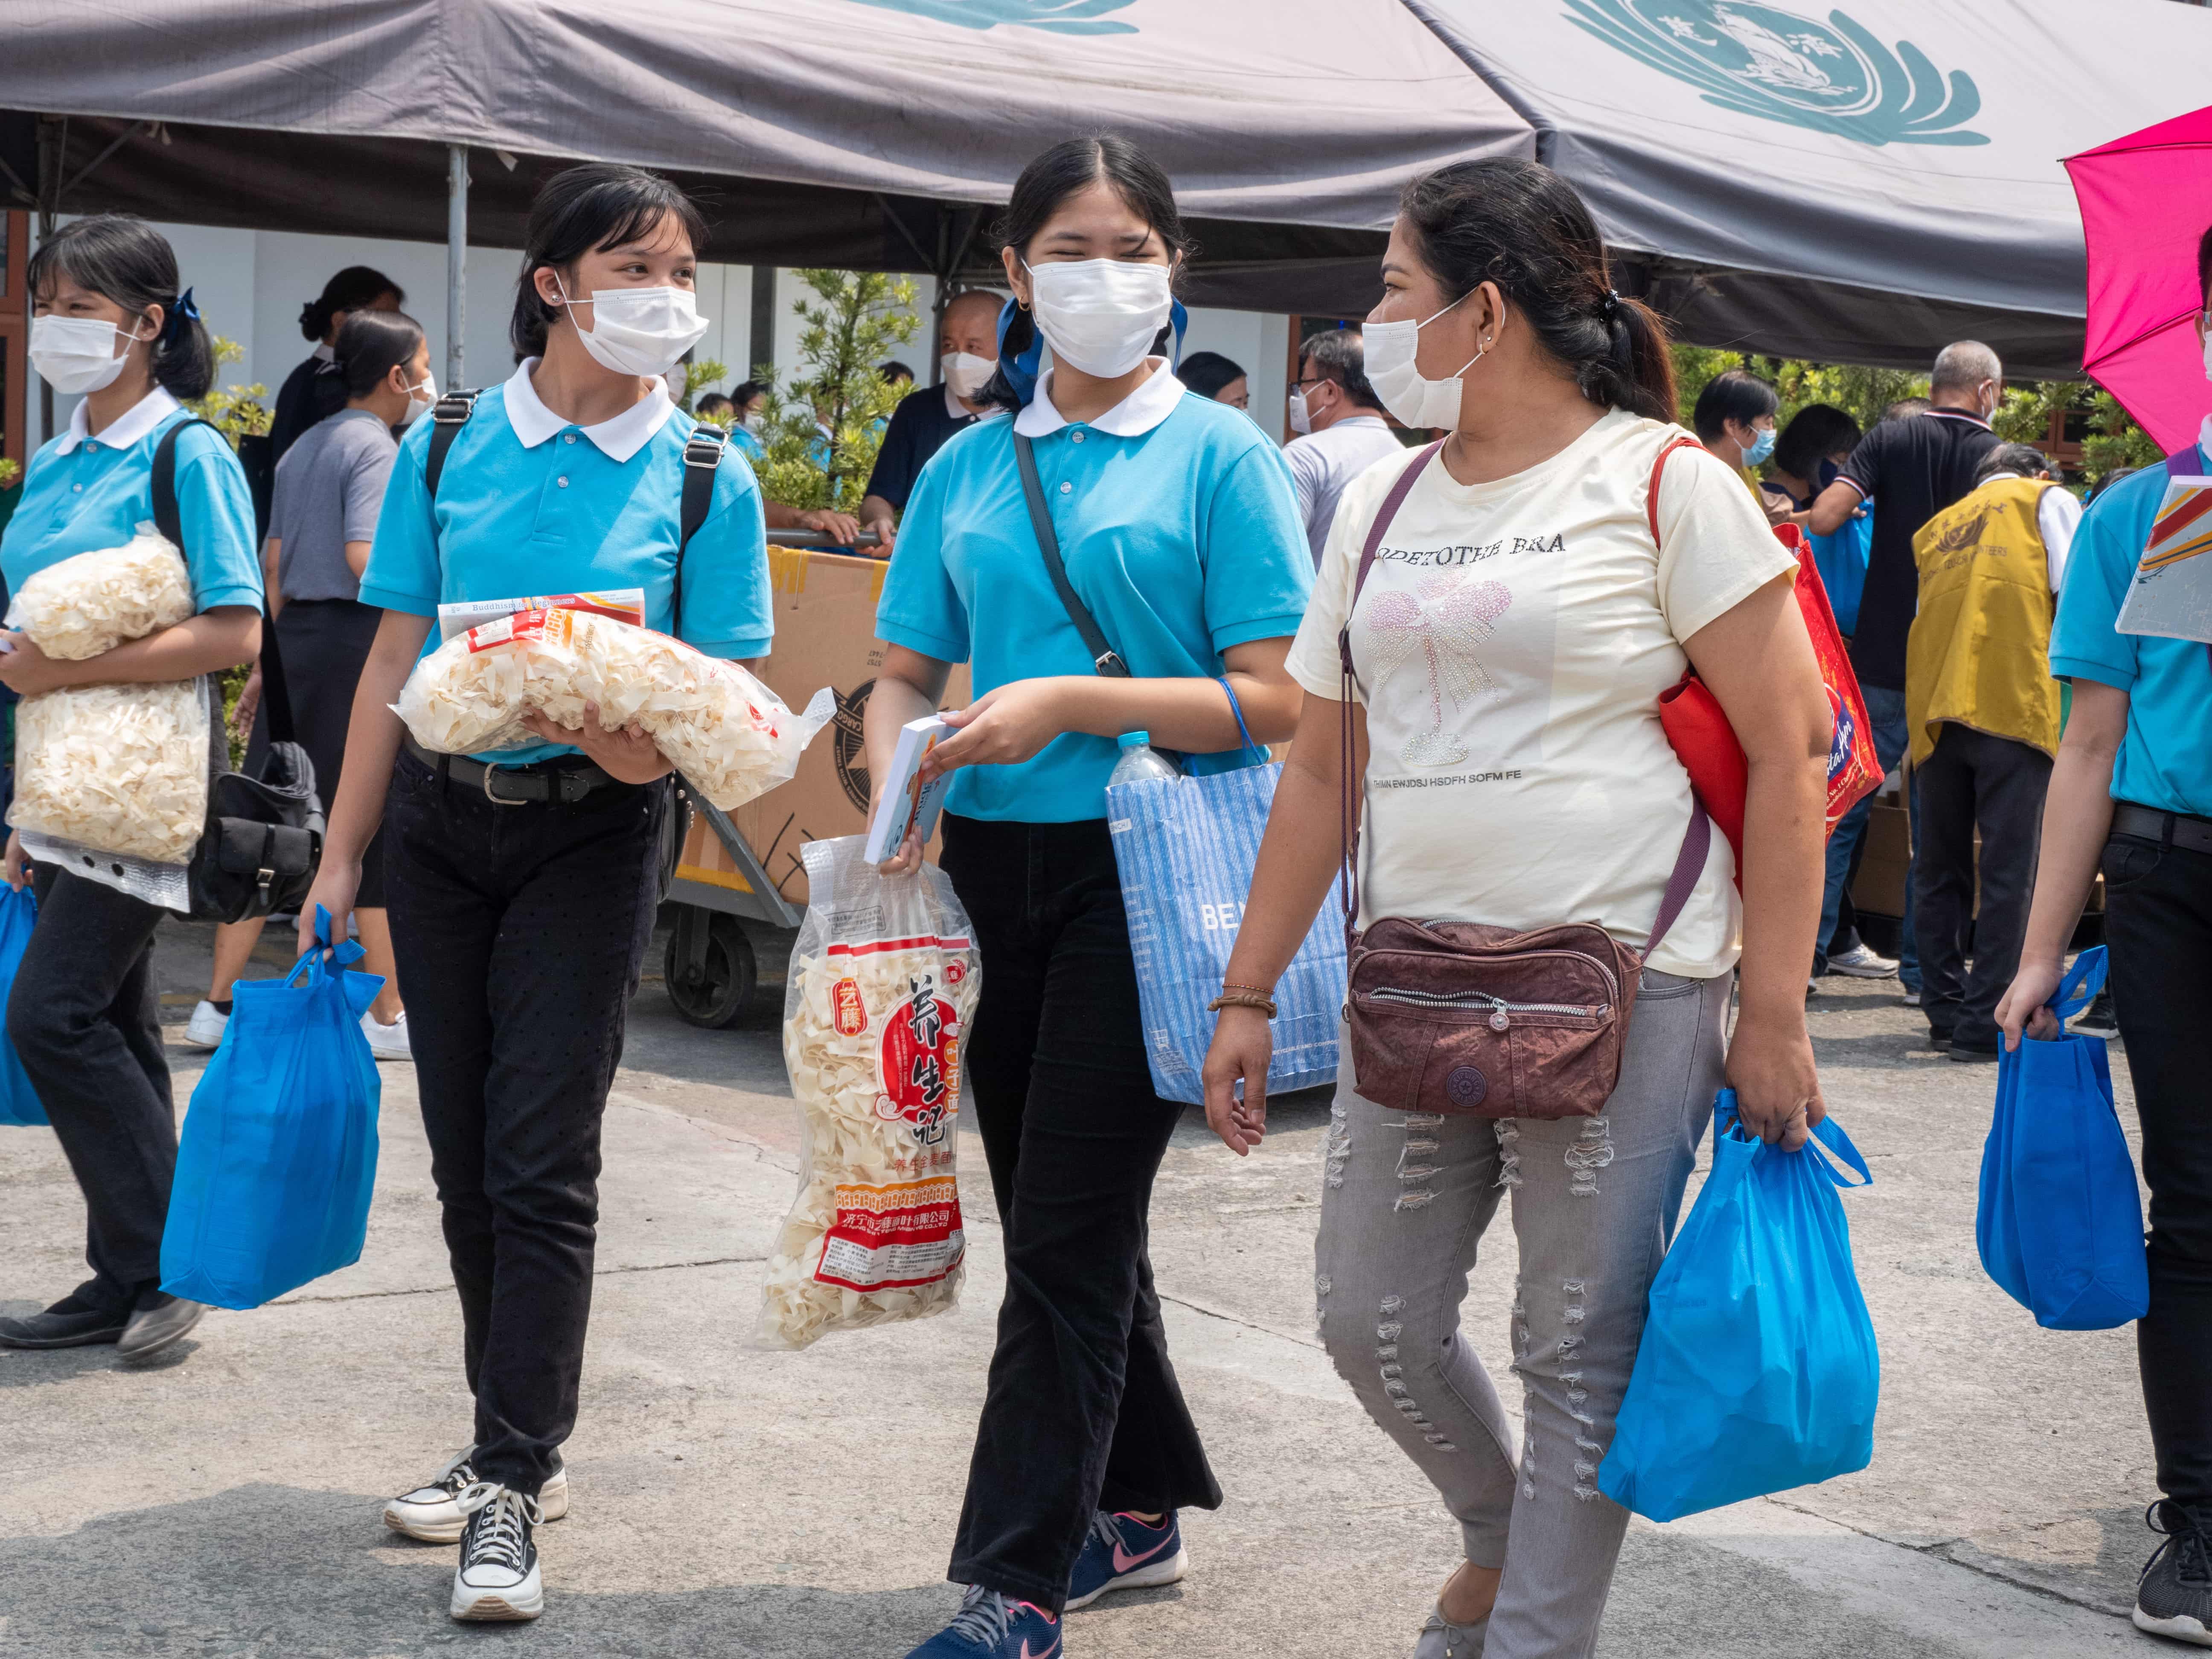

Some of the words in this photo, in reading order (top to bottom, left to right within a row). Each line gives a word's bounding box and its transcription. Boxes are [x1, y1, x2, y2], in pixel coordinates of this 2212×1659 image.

[1509, 533, 1566, 554] BRA
[472, 602, 516, 612] Buddhism
[531, 597, 575, 609] Beginners
[837, 711, 863, 732] CARGO
[1392, 779, 1428, 788] EWJDSJ
[1429, 775, 1466, 787] HSDFH
[1468, 772, 1503, 783] SOFM
[1506, 770, 1522, 780] FE
[1829, 787, 1839, 797] No.
[839, 986, 862, 1028] 艺藤
[908, 974, 945, 1145] 养生记
[1452, 1071, 1480, 1085] KIPLING
[894, 1151, 952, 1172] 养生全麦面
